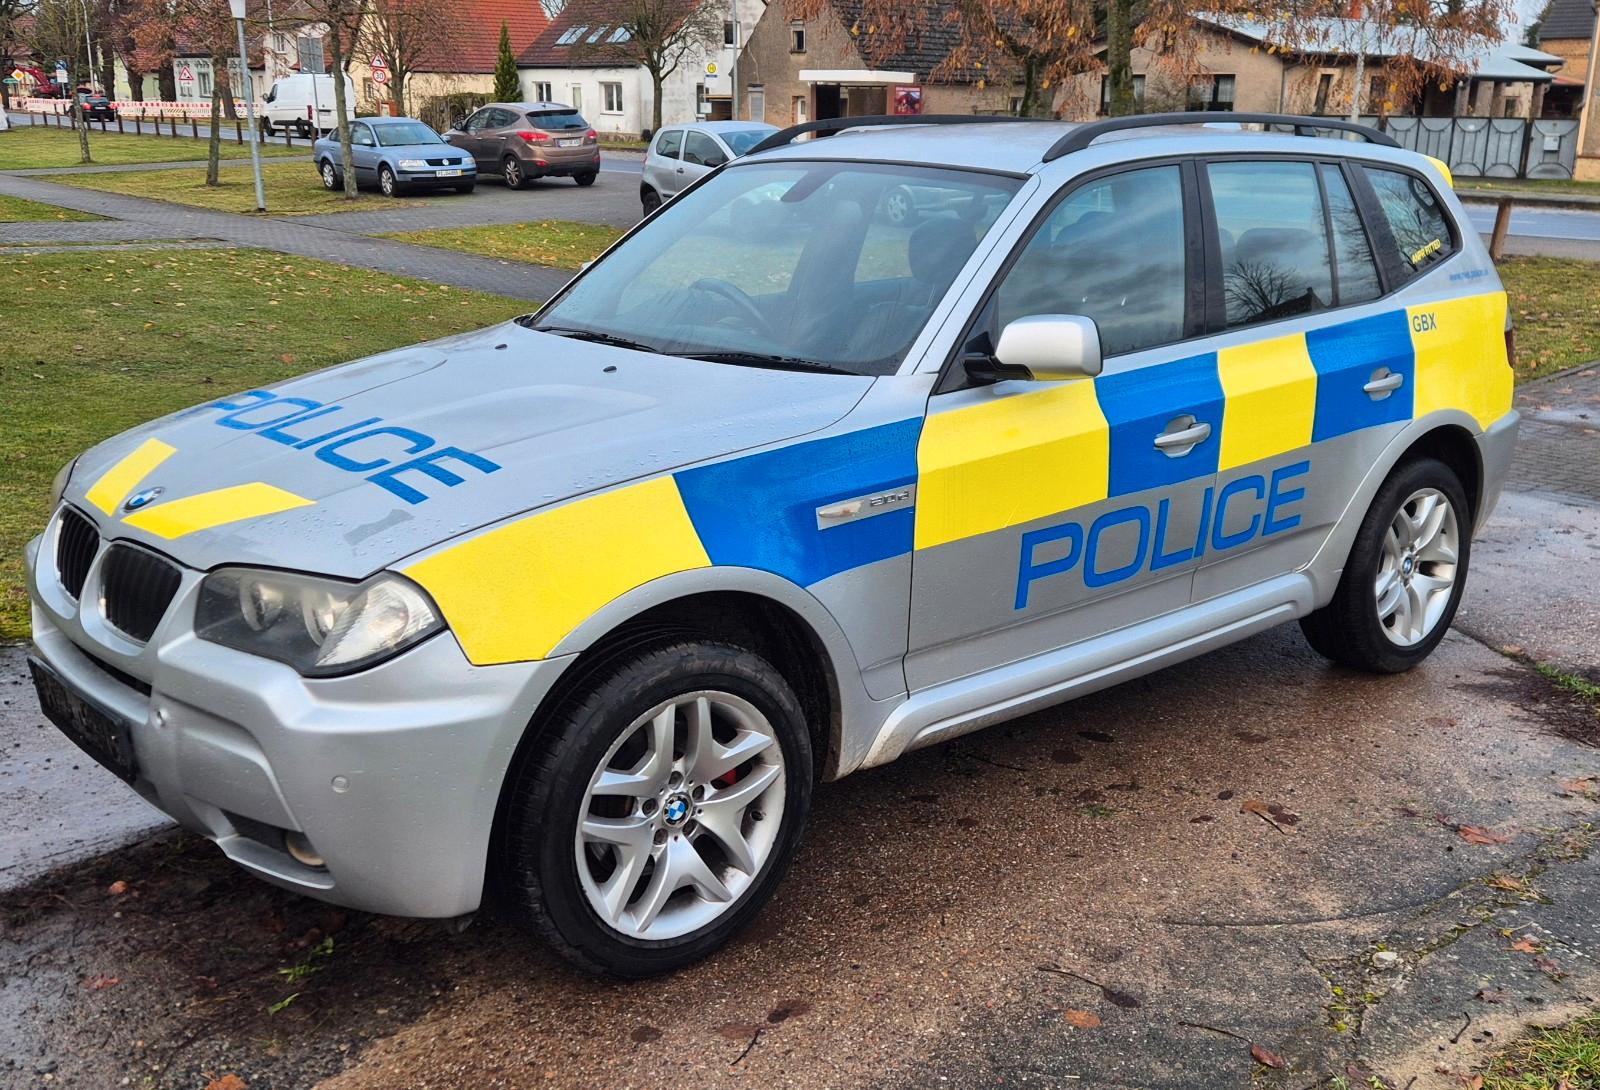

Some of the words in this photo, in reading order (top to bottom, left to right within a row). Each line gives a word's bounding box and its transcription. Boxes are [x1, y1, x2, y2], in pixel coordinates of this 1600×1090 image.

[1412, 312, 1437, 333] GBX
[205, 390, 502, 505] POLICE
[1014, 460, 1310, 610] POLICE
